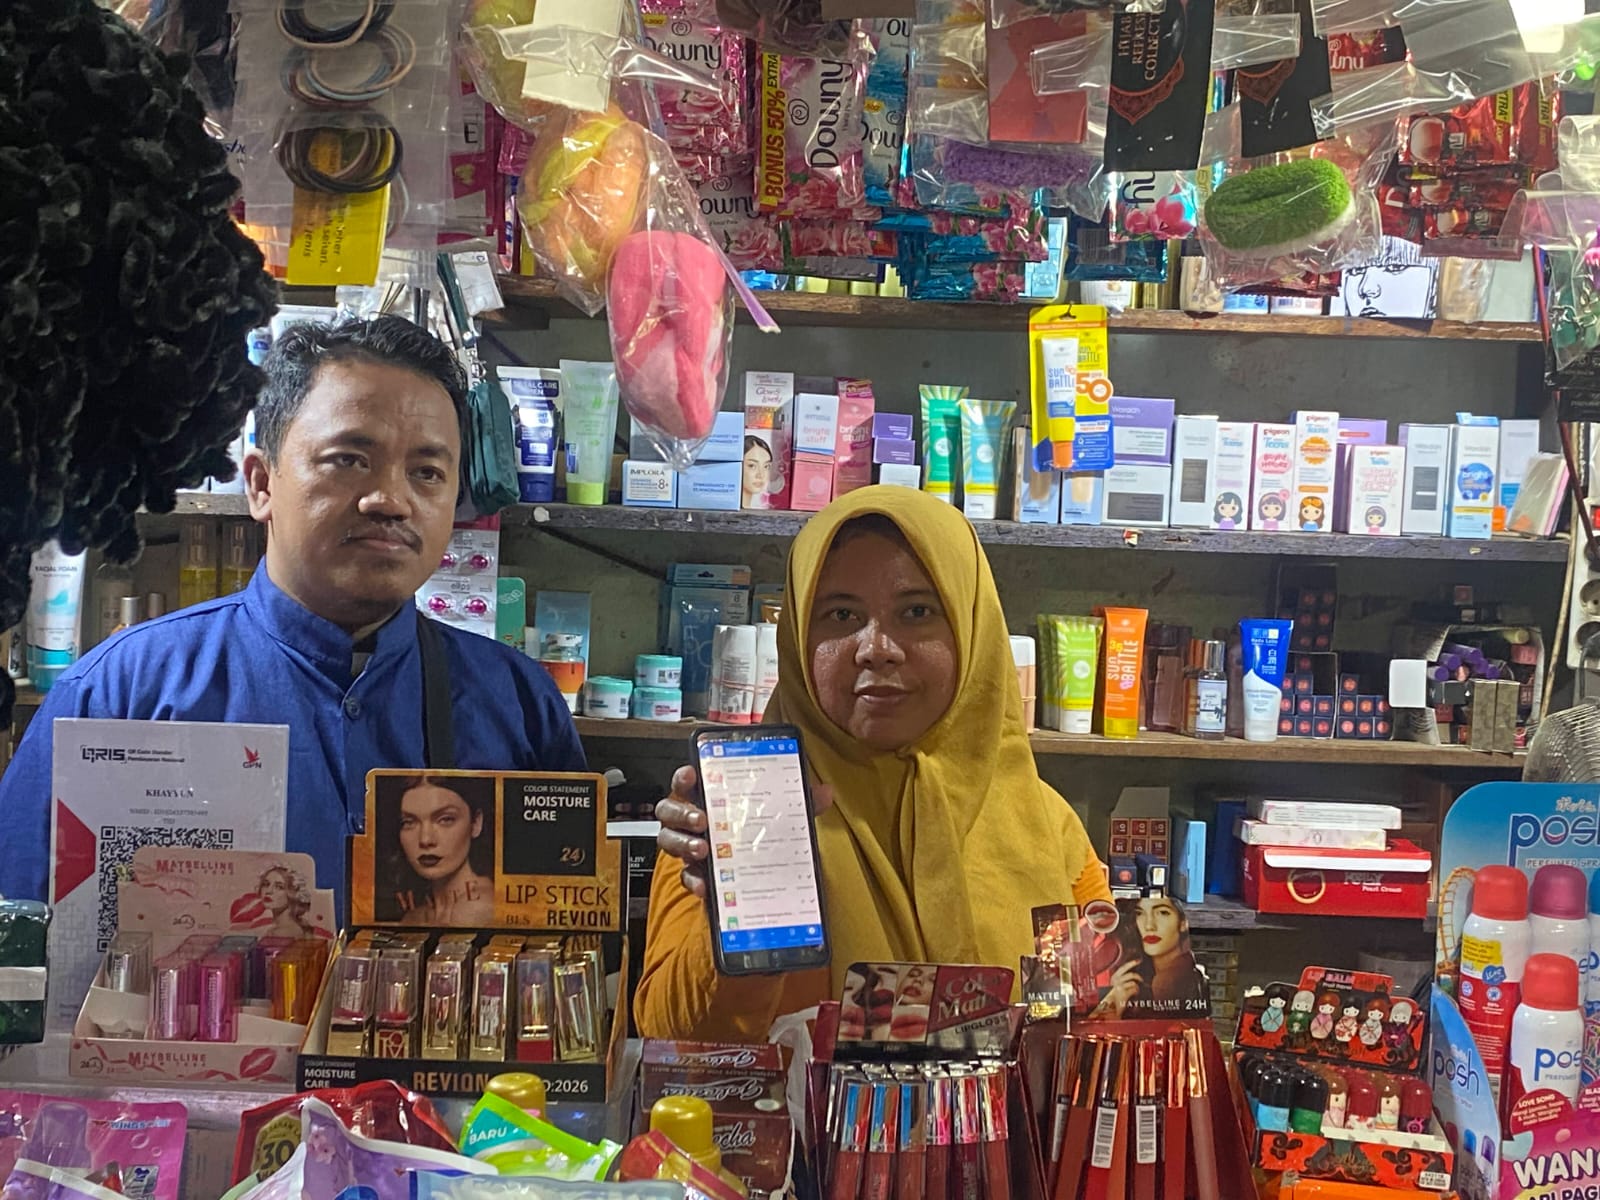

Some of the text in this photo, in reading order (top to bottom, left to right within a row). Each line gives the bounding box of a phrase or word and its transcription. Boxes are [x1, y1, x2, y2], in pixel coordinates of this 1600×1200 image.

[767, 54, 778, 89] EXTRA
[766, 90, 786, 132] 50%
[810, 59, 854, 169] Downy
[765, 135, 786, 199] BONUS
[1076, 372, 1112, 403] 50
[81, 747, 126, 763] QRIS
[523, 796, 591, 808] MOISTURE
[523, 810, 557, 822] CARE
[156, 860, 234, 872] MAYBELLINE
[505, 884, 610, 906] LIP STICK
[1027, 992, 1061, 1001] MATTE
[1120, 999, 1207, 1011] MAYBELLINE 24H
[954, 1016, 1007, 1034] LIPGLOSS
[128, 1052, 207, 1065] MAYBELLINE
[304, 1068, 356, 1080] MOISTURE
[1433, 1048, 1479, 1096] posh
[304, 1079, 330, 1089] CARE
[1519, 1098, 1535, 1108] LOVE
[469, 1126, 508, 1146] BARU
[260, 1139, 295, 1170] 30
[1513, 1147, 1600, 1189] WAN
